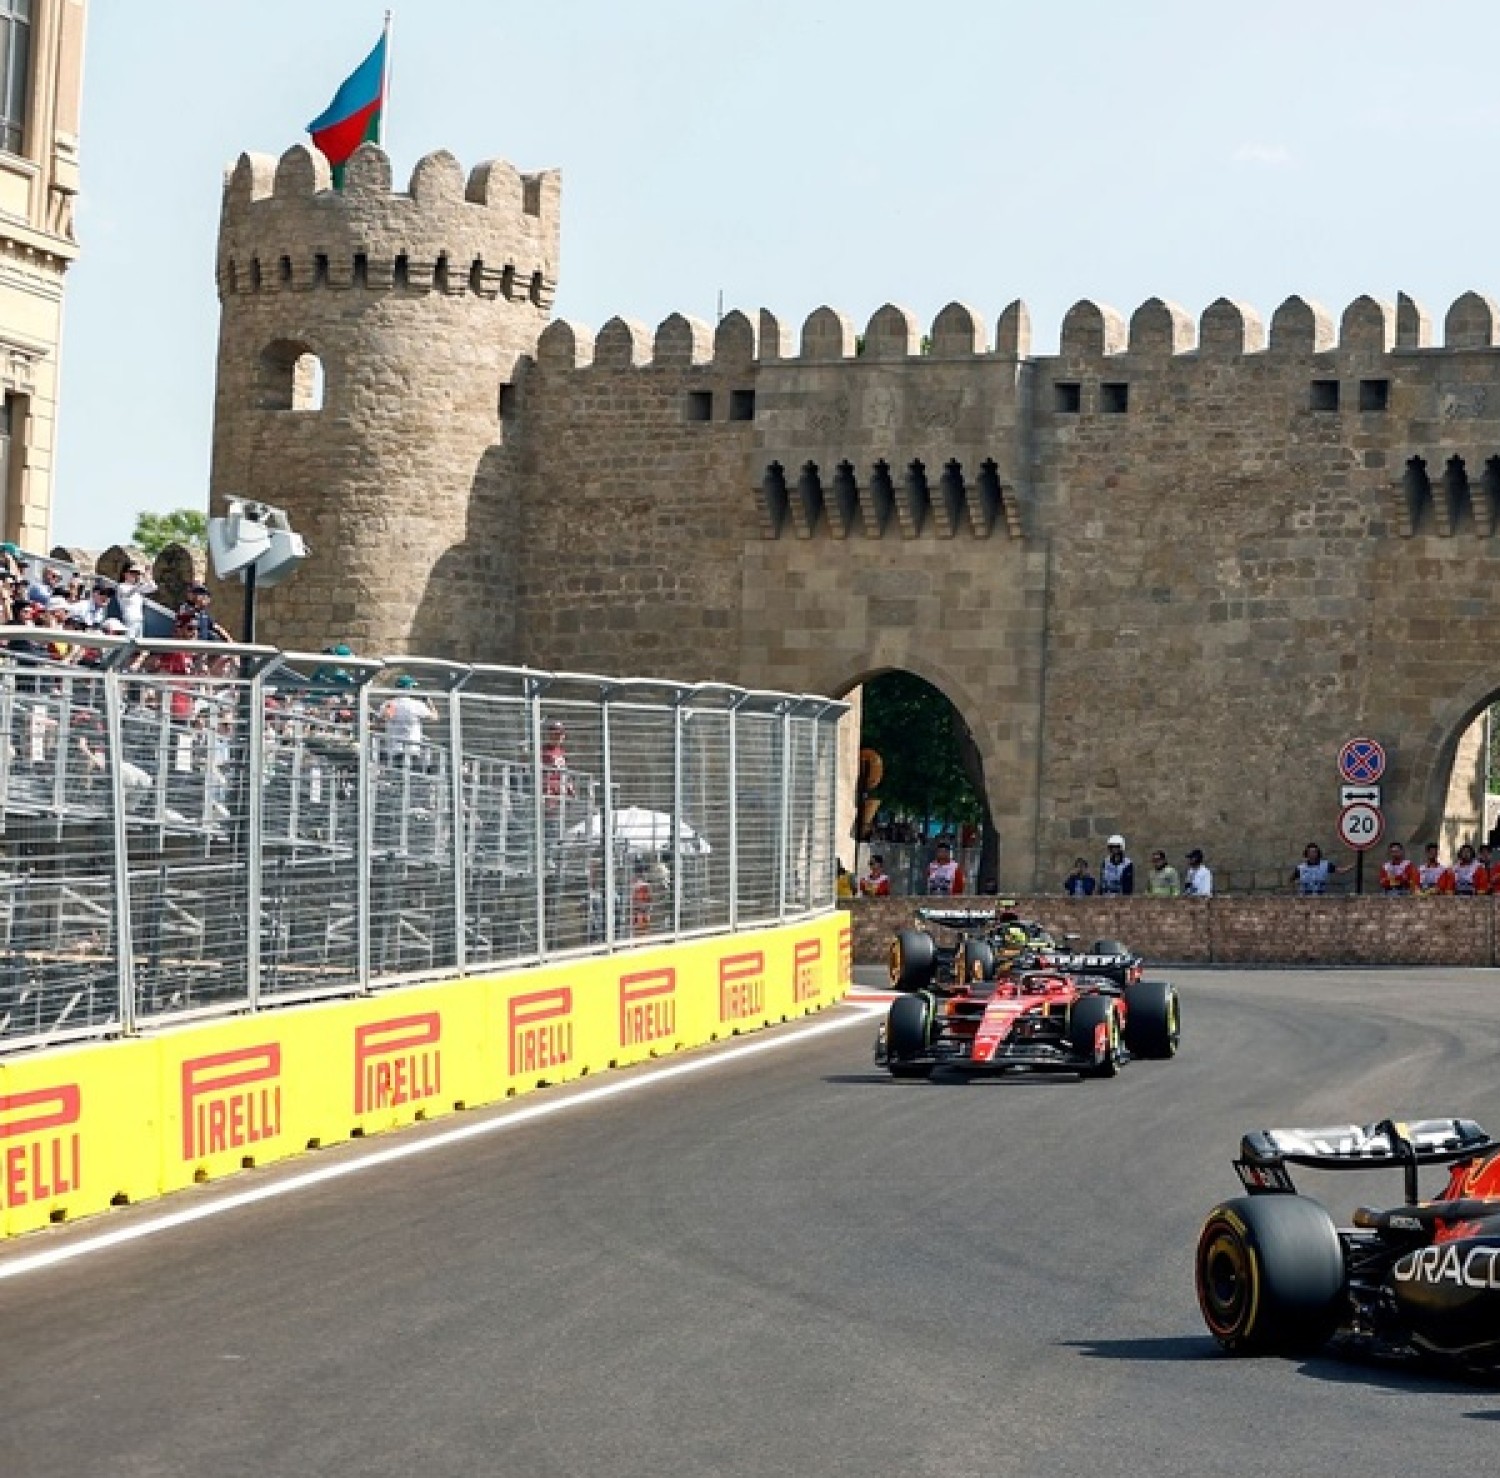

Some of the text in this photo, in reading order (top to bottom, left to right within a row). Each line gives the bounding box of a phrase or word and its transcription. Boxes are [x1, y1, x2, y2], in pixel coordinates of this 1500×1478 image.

[1349, 814, 1374, 834] 20
[620, 966, 676, 1048] PIRELLI
[719, 950, 764, 1023] PIRELLI
[354, 1010, 441, 1115] PIRELLI
[508, 986, 574, 1077] PIRELLI
[181, 1042, 281, 1161] PIRELLI
